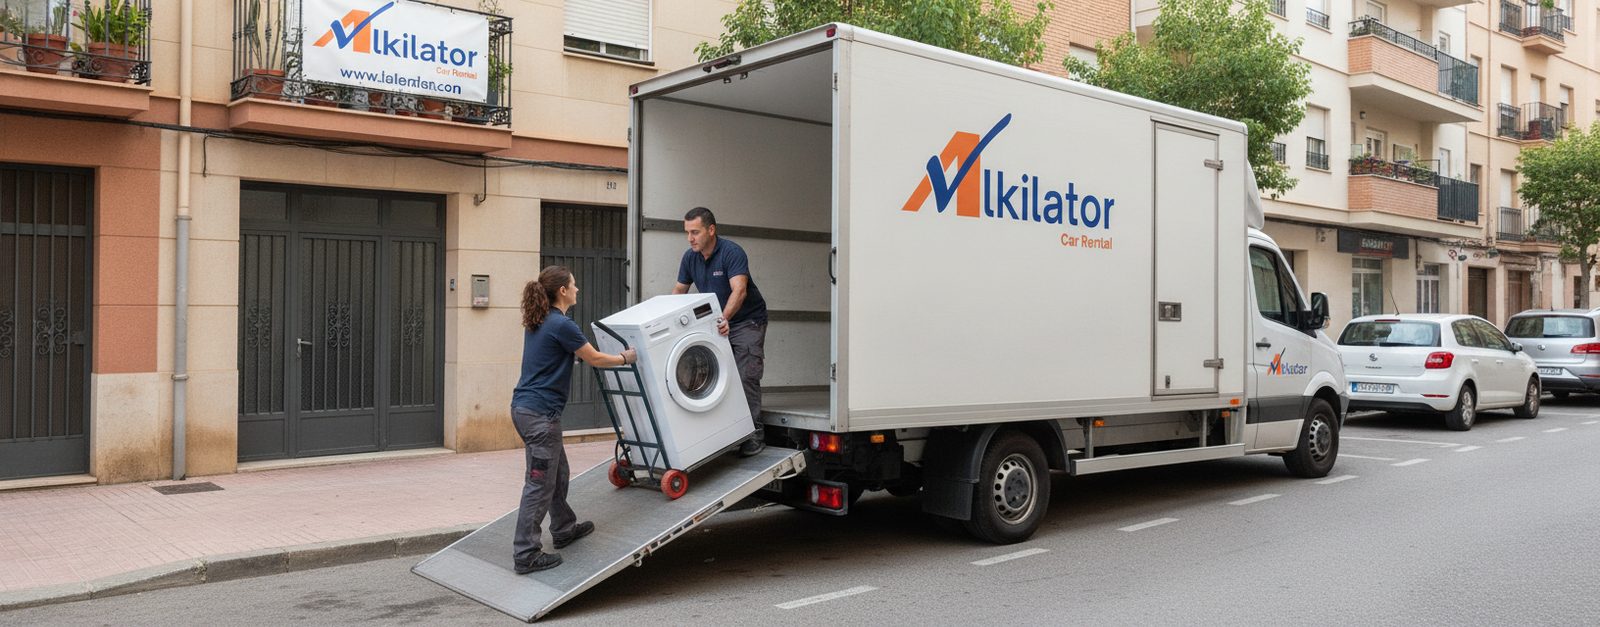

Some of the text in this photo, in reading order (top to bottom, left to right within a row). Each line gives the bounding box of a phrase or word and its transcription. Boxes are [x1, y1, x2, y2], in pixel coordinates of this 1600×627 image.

[313, 2, 477, 67] Alkilator
[901, 113, 1115, 230] Alkilator
[1061, 233, 1113, 250] Car Rental
